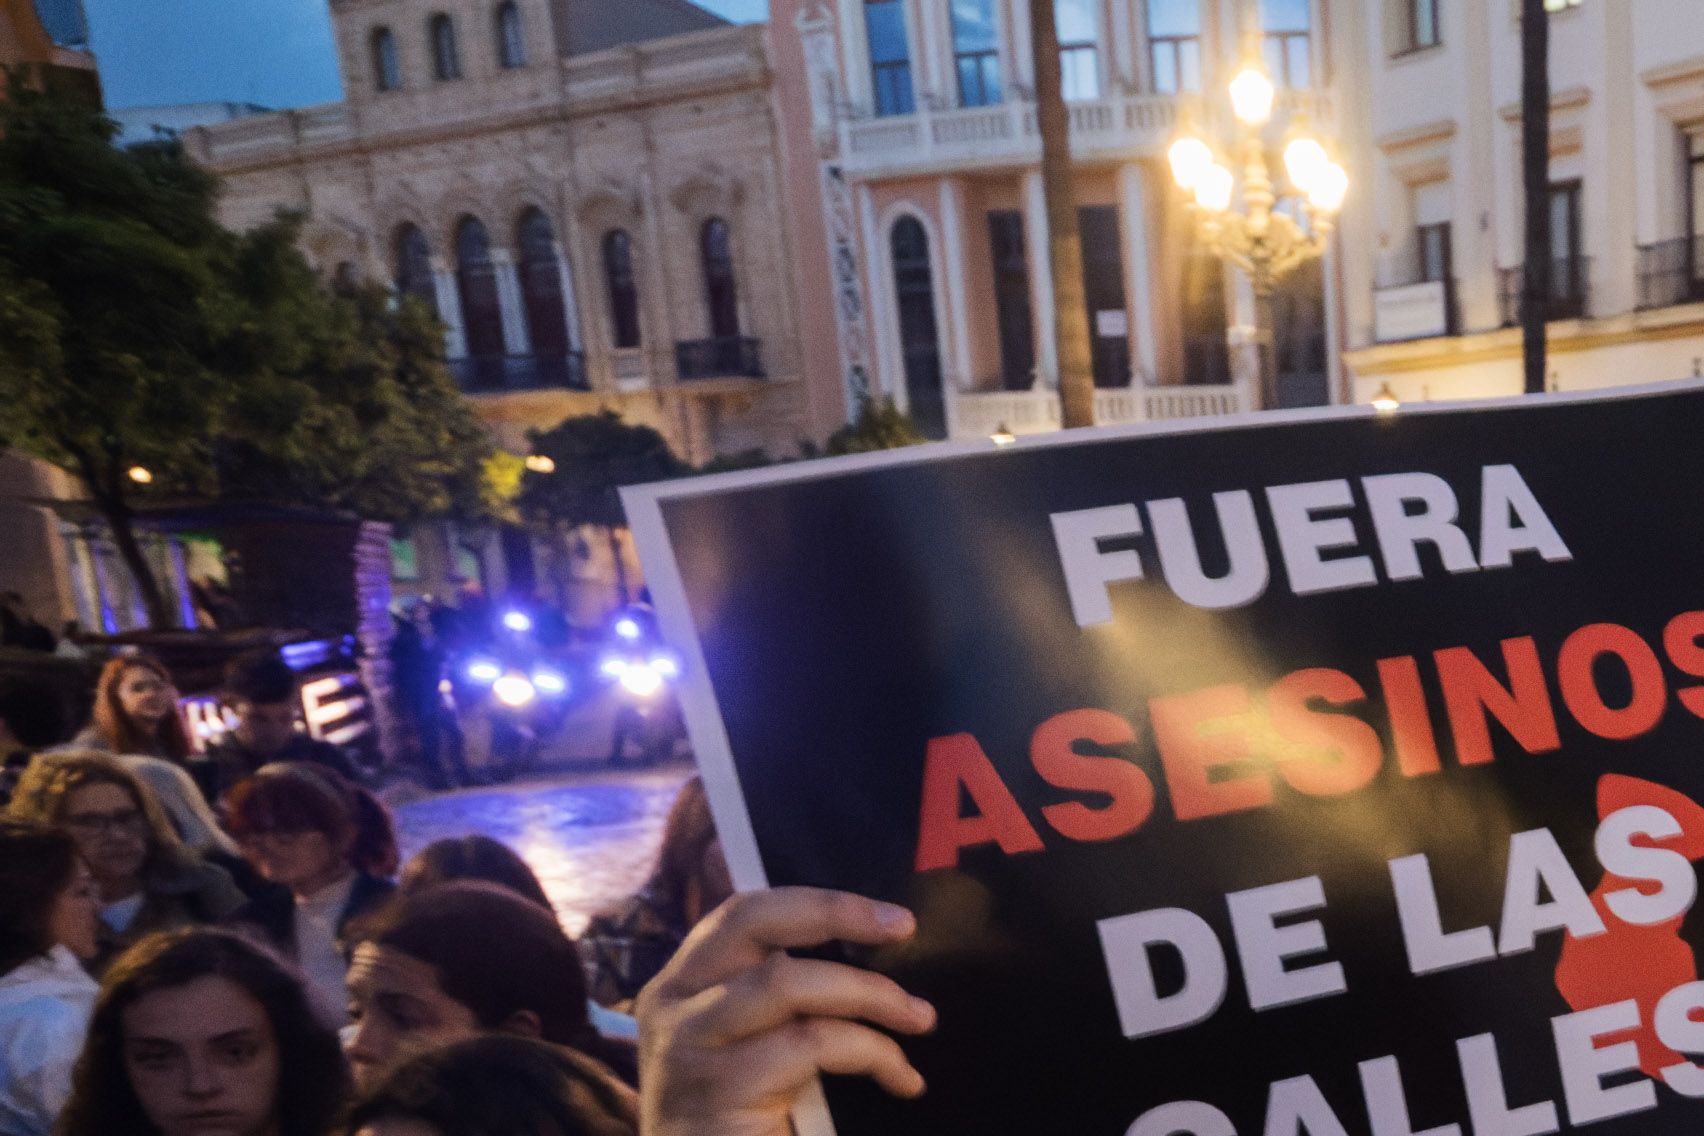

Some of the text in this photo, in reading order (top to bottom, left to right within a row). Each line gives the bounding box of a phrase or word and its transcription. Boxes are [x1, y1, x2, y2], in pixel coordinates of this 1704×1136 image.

[1049, 463, 1573, 628] FUERA
[1096, 804, 1698, 1040] DE LAS
